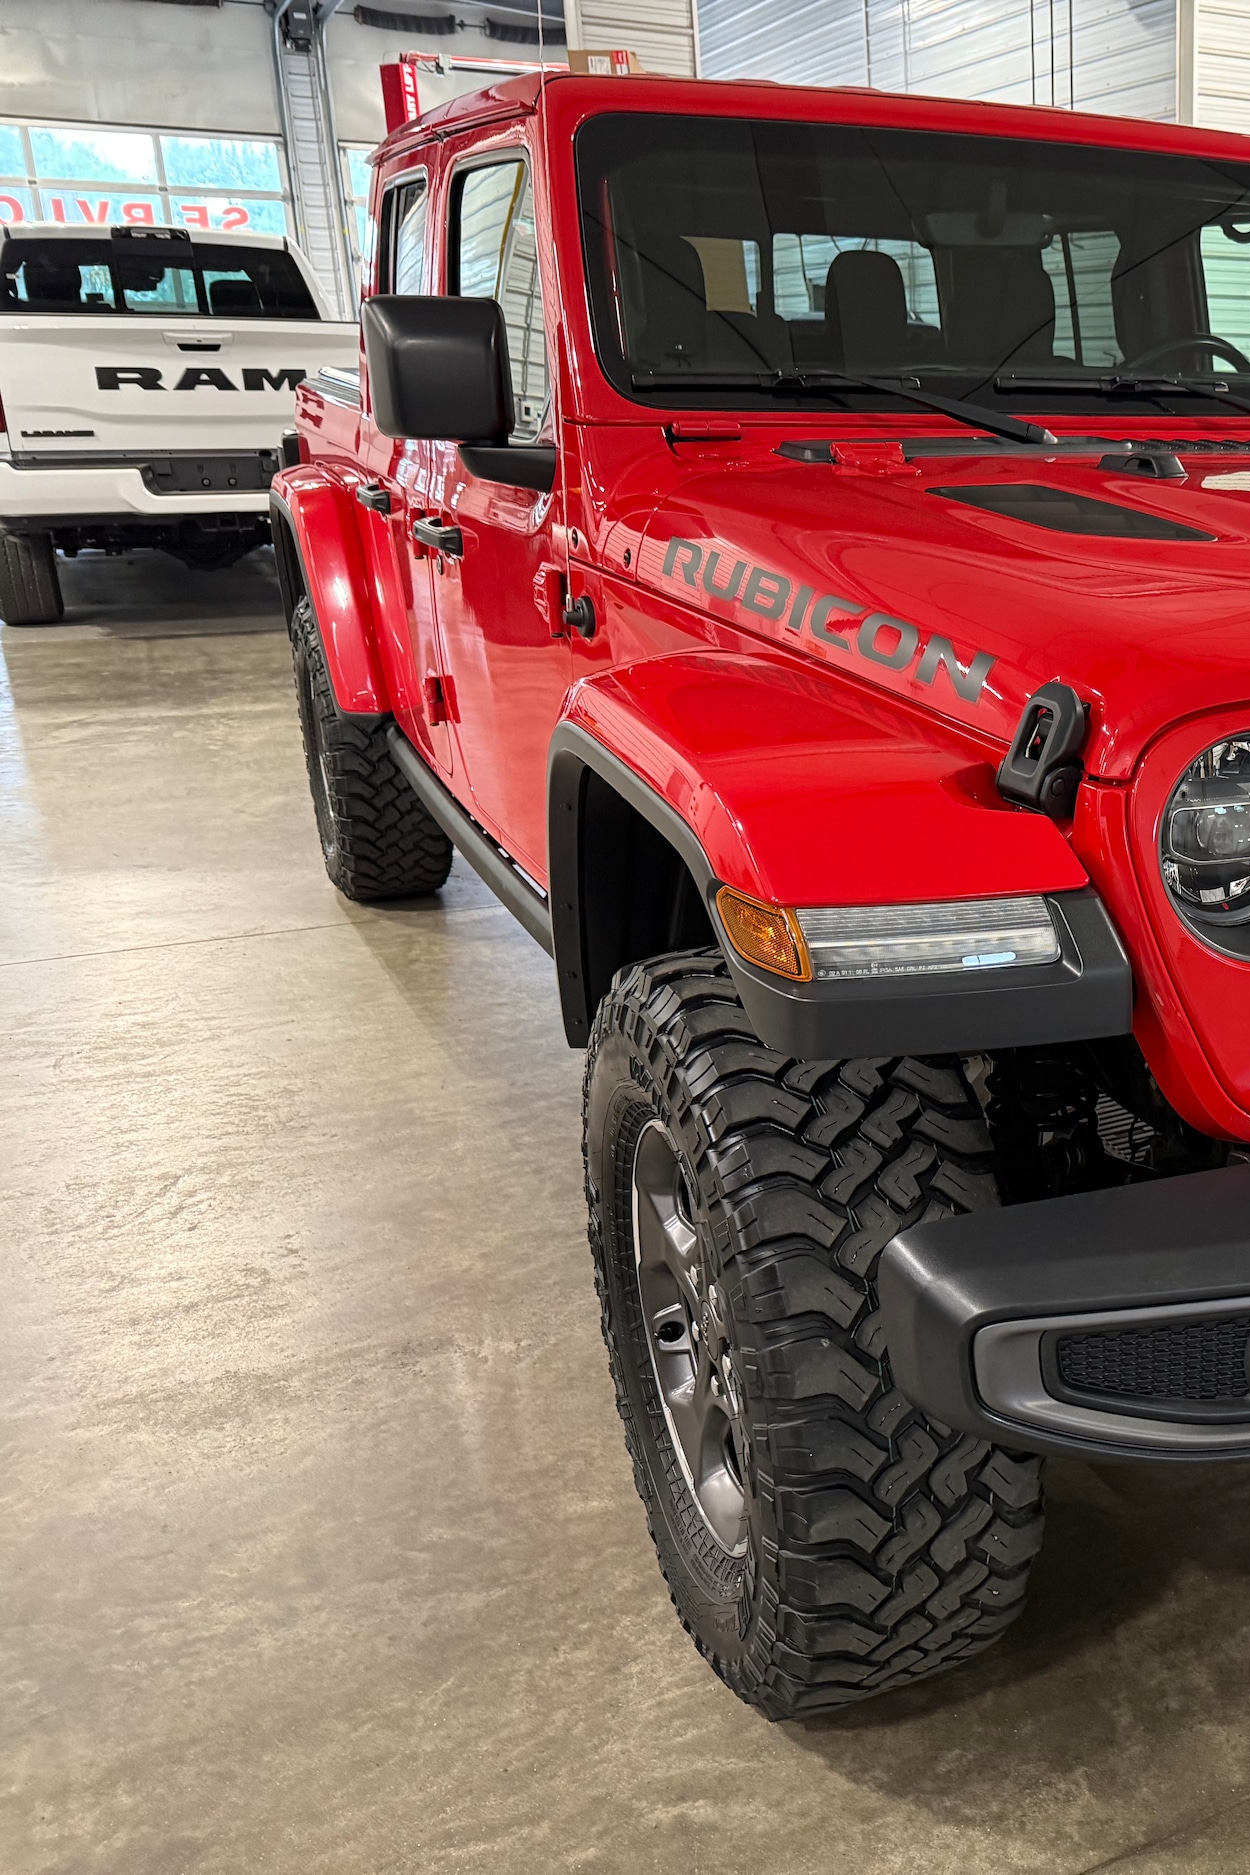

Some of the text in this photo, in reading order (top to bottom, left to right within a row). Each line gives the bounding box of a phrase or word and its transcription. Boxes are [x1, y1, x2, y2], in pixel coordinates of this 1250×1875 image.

[402, 63, 415, 93] LIFT
[95, 366, 307, 391] RAM
[662, 536, 997, 704] RUBICON
